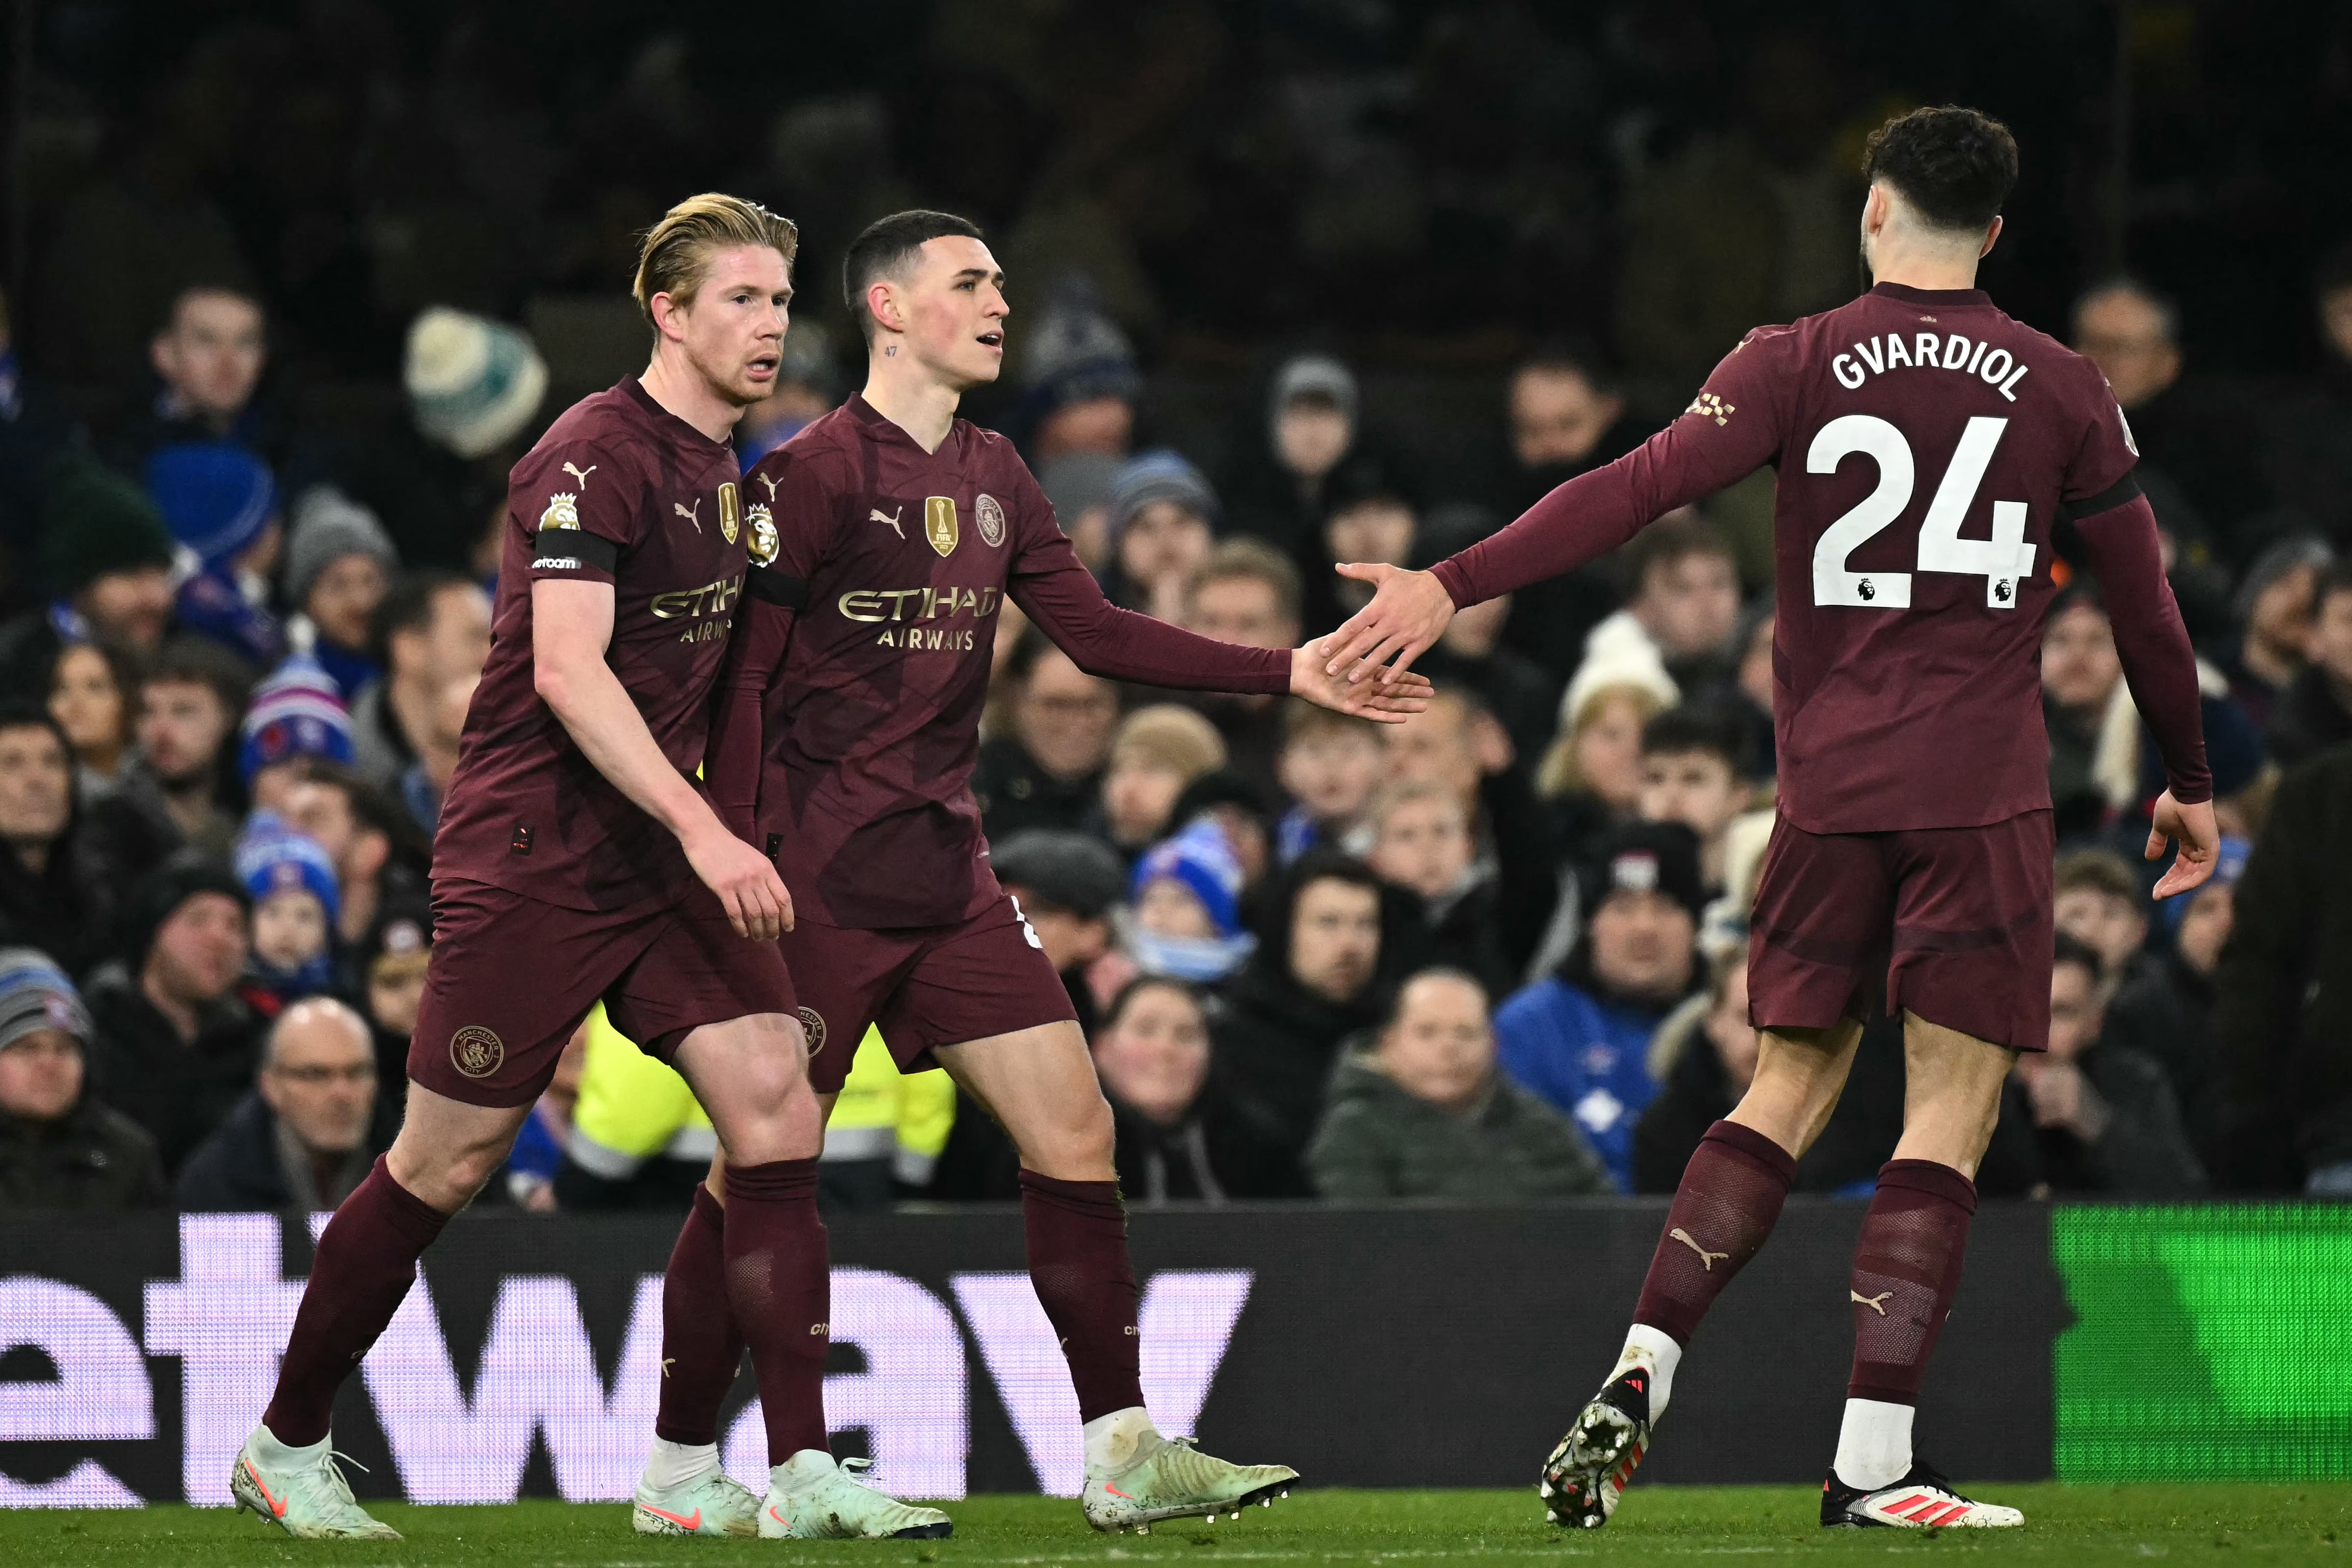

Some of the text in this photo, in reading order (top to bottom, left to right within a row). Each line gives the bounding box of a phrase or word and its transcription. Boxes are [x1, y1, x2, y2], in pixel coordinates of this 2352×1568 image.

[885, 346, 897, 357] 47
[1832, 333, 2029, 402] GVARDIOL
[1806, 414, 2037, 608] 24
[936, 533, 951, 541] FIFA
[650, 575, 744, 619] ETIH
[838, 586, 997, 622] ETIHAD
[877, 628, 973, 651] AIRWAYS
[800, 1011, 822, 1030] HESTER
[458, 1030, 499, 1051] MANCHESTER
